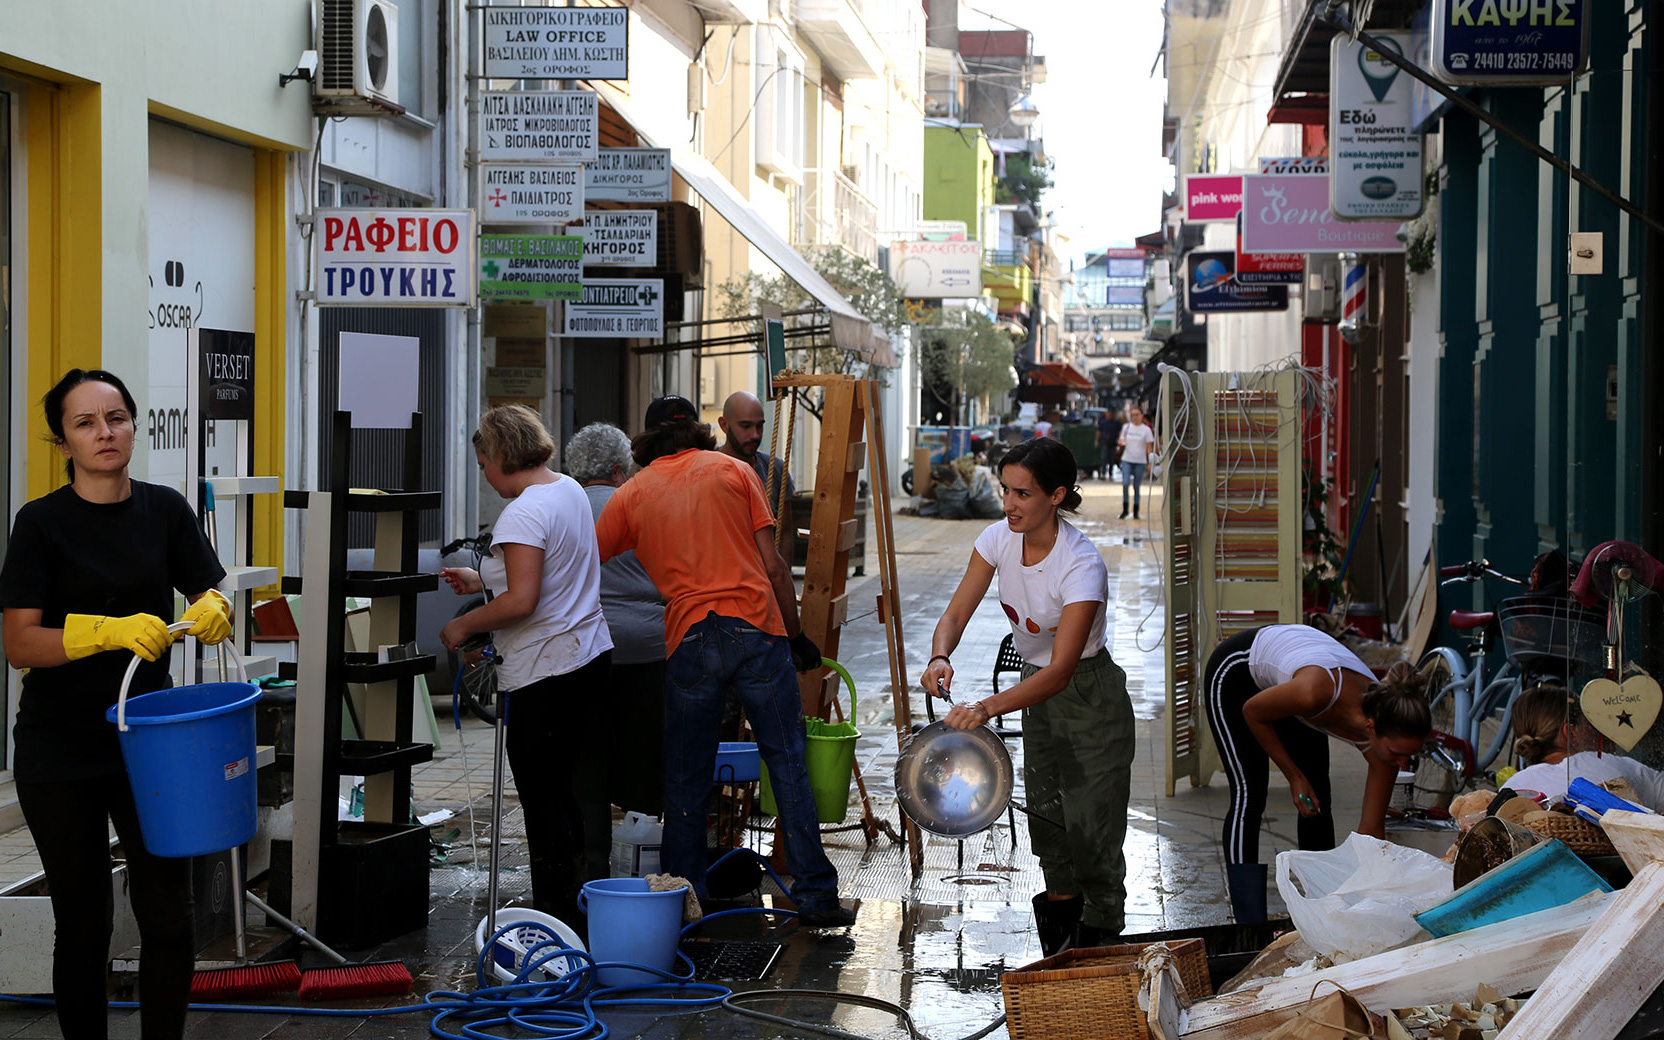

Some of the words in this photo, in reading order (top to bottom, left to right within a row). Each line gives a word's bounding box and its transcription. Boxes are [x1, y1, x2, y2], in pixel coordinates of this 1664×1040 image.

[488, 11, 566, 26] ΔΙΚΗΓΟΡΙΚΟ
[570, 12, 624, 26] ΓΡΑΦΕΙΟ
[506, 30, 540, 42] LAW
[546, 30, 606, 43] OFFICE
[488, 46, 550, 60] ΒΑΣΙΛΕΙΟΥ
[552, 47, 581, 60] ΔΗΜ.
[584, 48, 624, 61] ΚΩΣΤΗ
[1474, 52, 1504, 69] 24410
[1507, 52, 1574, 69] 23572-75449
[521, 65, 537, 75] 2ος
[543, 65, 591, 74] ΟΡΟΦΟΣ
[484, 96, 509, 115] ΛΙΤΣΑ
[513, 96, 563, 115] ΔΑΣΚΑΛΑΚΗ
[1340, 109, 1376, 124] Εδώ
[486, 118, 518, 132] ΙΑΤΡΟΣ
[524, 118, 592, 132] ΜΙΚΡΟΒΙΟΛΟΓΟΣ
[505, 134, 592, 148] ΒΙΟΠΑΘΟΛΟΓΟΣ
[488, 170, 525, 184] ΑΓΓΕΛΗΣ
[530, 171, 576, 185] ΒΑΣΙΛΕΙΟΣ
[592, 175, 644, 184] ΔΙΚΗΓΟΡΟΣ
[511, 191, 573, 205] ΠΑΙΔΙΑΤΡΟΣ
[1191, 192, 1218, 207] pink
[604, 216, 652, 227] ΔΗΜΗΤΡΙΟΥ
[324, 217, 459, 254] ΡΑΦΕΙΟ
[1318, 229, 1386, 246] Boutique
[483, 238, 514, 255] ΘΩΜΑΣ
[528, 239, 580, 256] ΒΑΣΙΛΑΚΟΣ
[508, 259, 580, 270] ΔΕΡΜΑΤΟΛΟΓΟΣ
[324, 267, 456, 297] ΤΡΟΥΚΗΣ
[502, 272, 580, 284] ΑΦΡΟΔΙΣΙΟΛΟΓΟΣ
[158, 303, 192, 328] OSCAR
[206, 353, 250, 380] VERSET
[216, 388, 239, 400] PARFUMS
